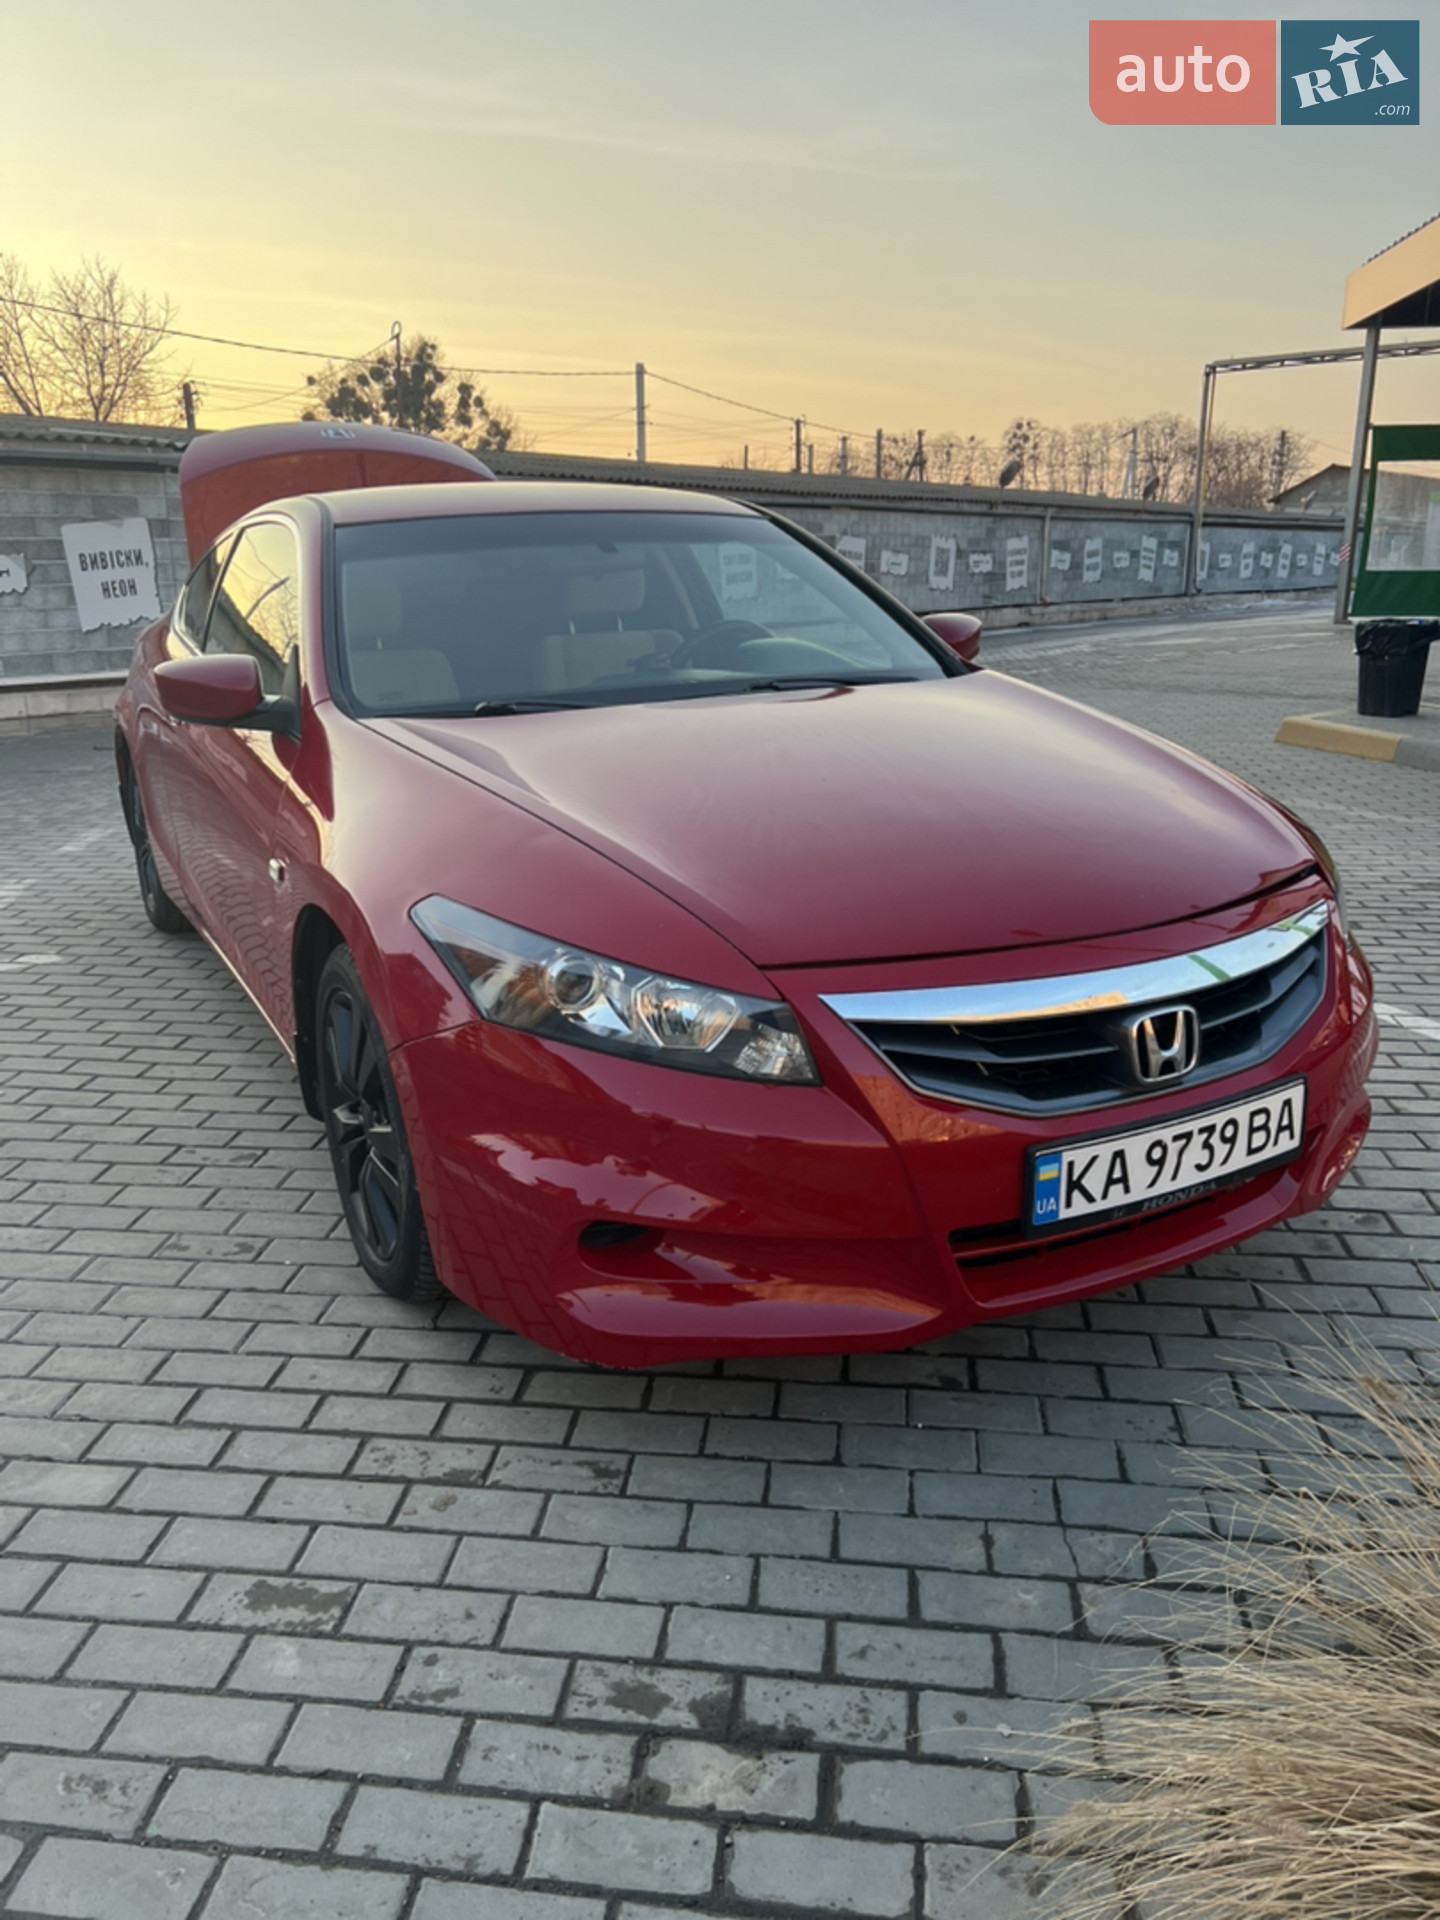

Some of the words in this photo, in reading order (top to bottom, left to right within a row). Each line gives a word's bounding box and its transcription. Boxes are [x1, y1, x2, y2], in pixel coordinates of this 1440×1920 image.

[78, 548, 150, 572] ВИВІСКИ,
[101, 578, 138, 599] НЕОН
[1064, 1149, 1131, 1209] KA
[1145, 1117, 1240, 1189] 9739
[1246, 1097, 1295, 1157] BA
[1036, 1197, 1057, 1215] UA
[1141, 1181, 1217, 1212] HONDA
